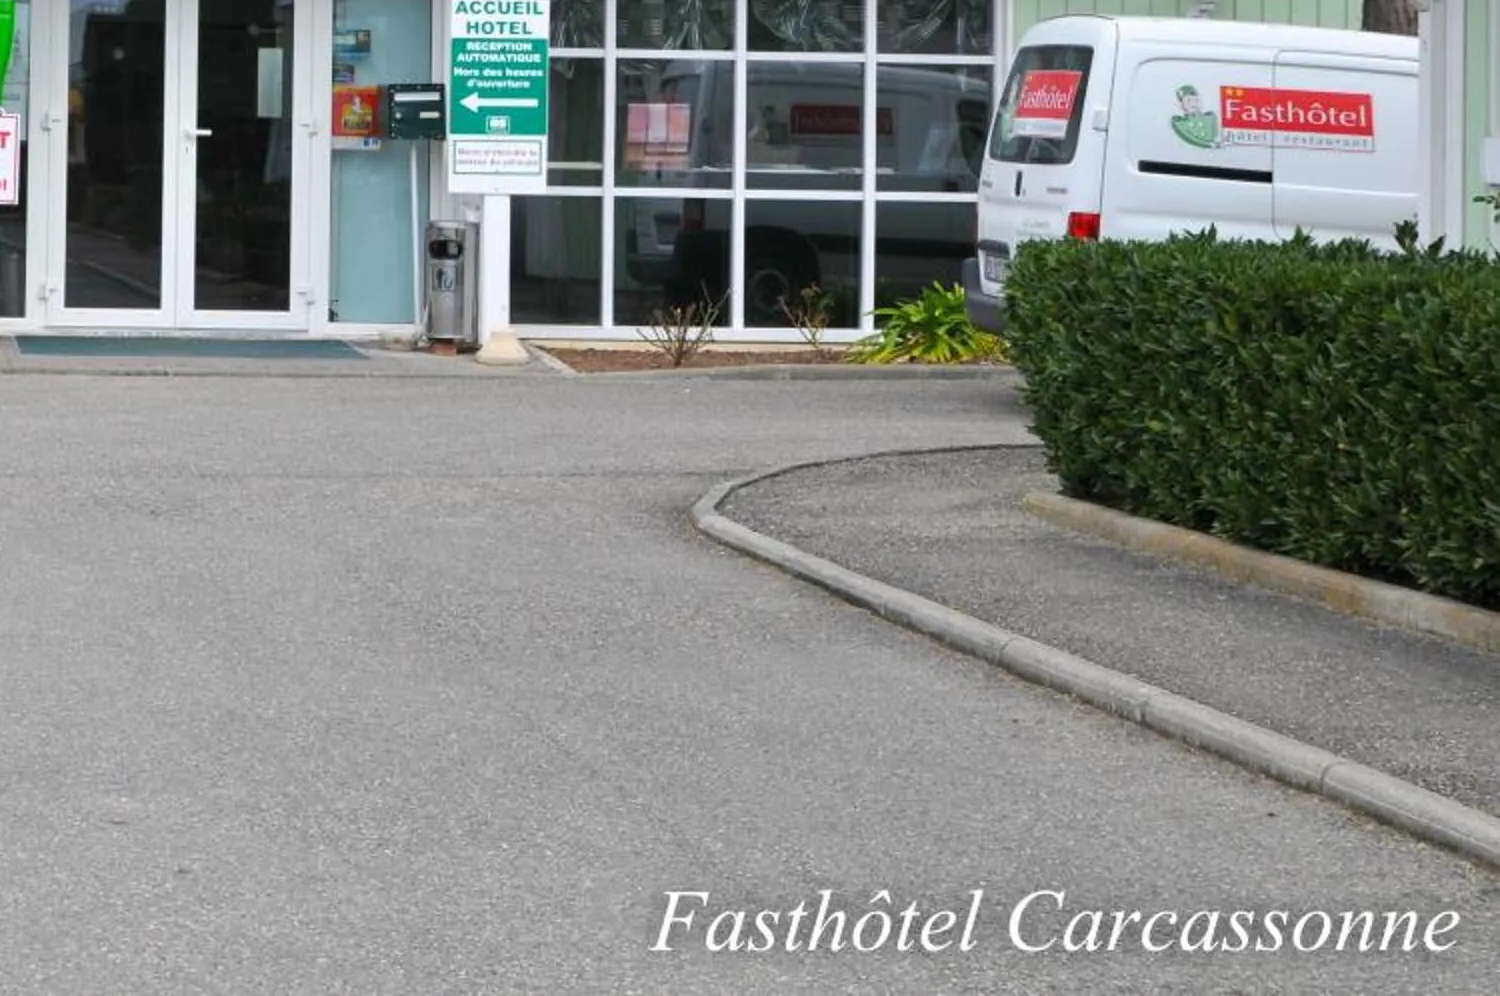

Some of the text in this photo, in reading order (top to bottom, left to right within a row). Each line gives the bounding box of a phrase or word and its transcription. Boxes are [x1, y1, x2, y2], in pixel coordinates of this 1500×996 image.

[454, 0, 544, 15] ACCUEIL
[466, 21, 533, 35] HOTEL
[457, 53, 541, 63] AUTOMATIQUE
[453, 67, 544, 77] Hors des heures
[466, 78, 531, 88] d'ouverture
[1225, 99, 1367, 128] Fasthôtel
